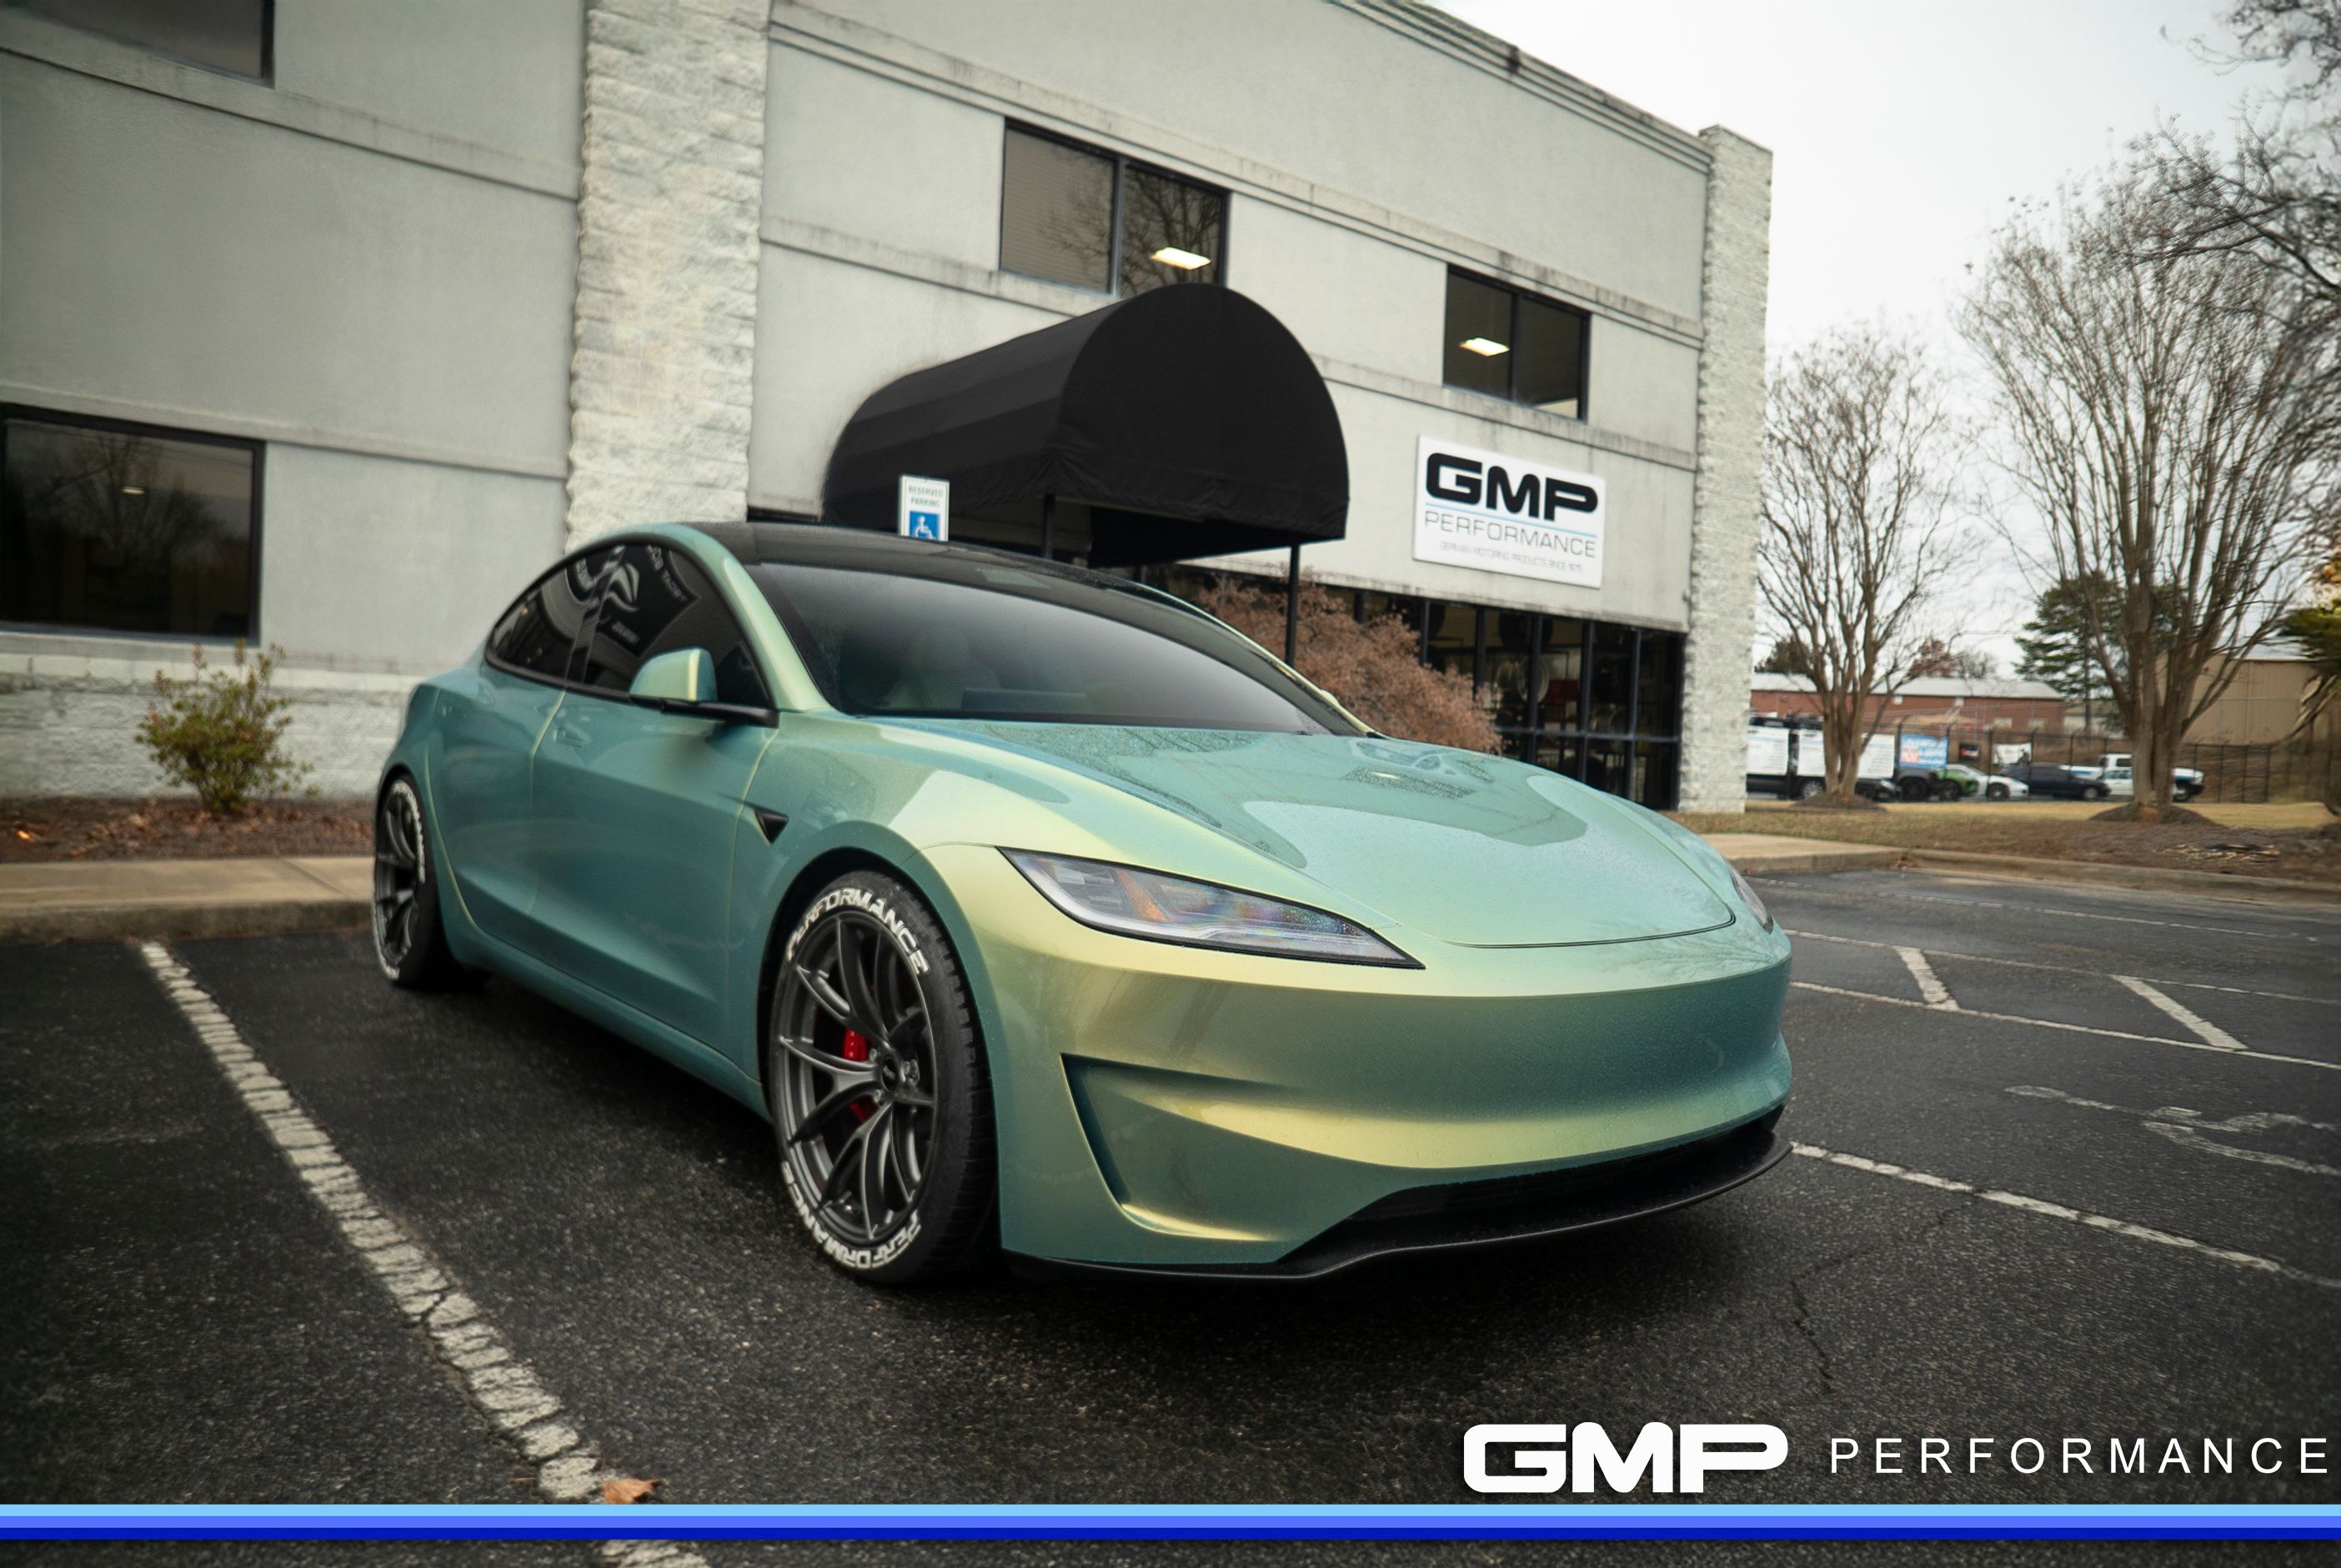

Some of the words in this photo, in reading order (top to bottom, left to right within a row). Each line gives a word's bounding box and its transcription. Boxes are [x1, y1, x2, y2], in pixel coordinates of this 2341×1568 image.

[910, 497, 940, 508] PARKING
[1426, 453, 1598, 522] GMP
[1424, 510, 1597, 559] PERFORMANCE
